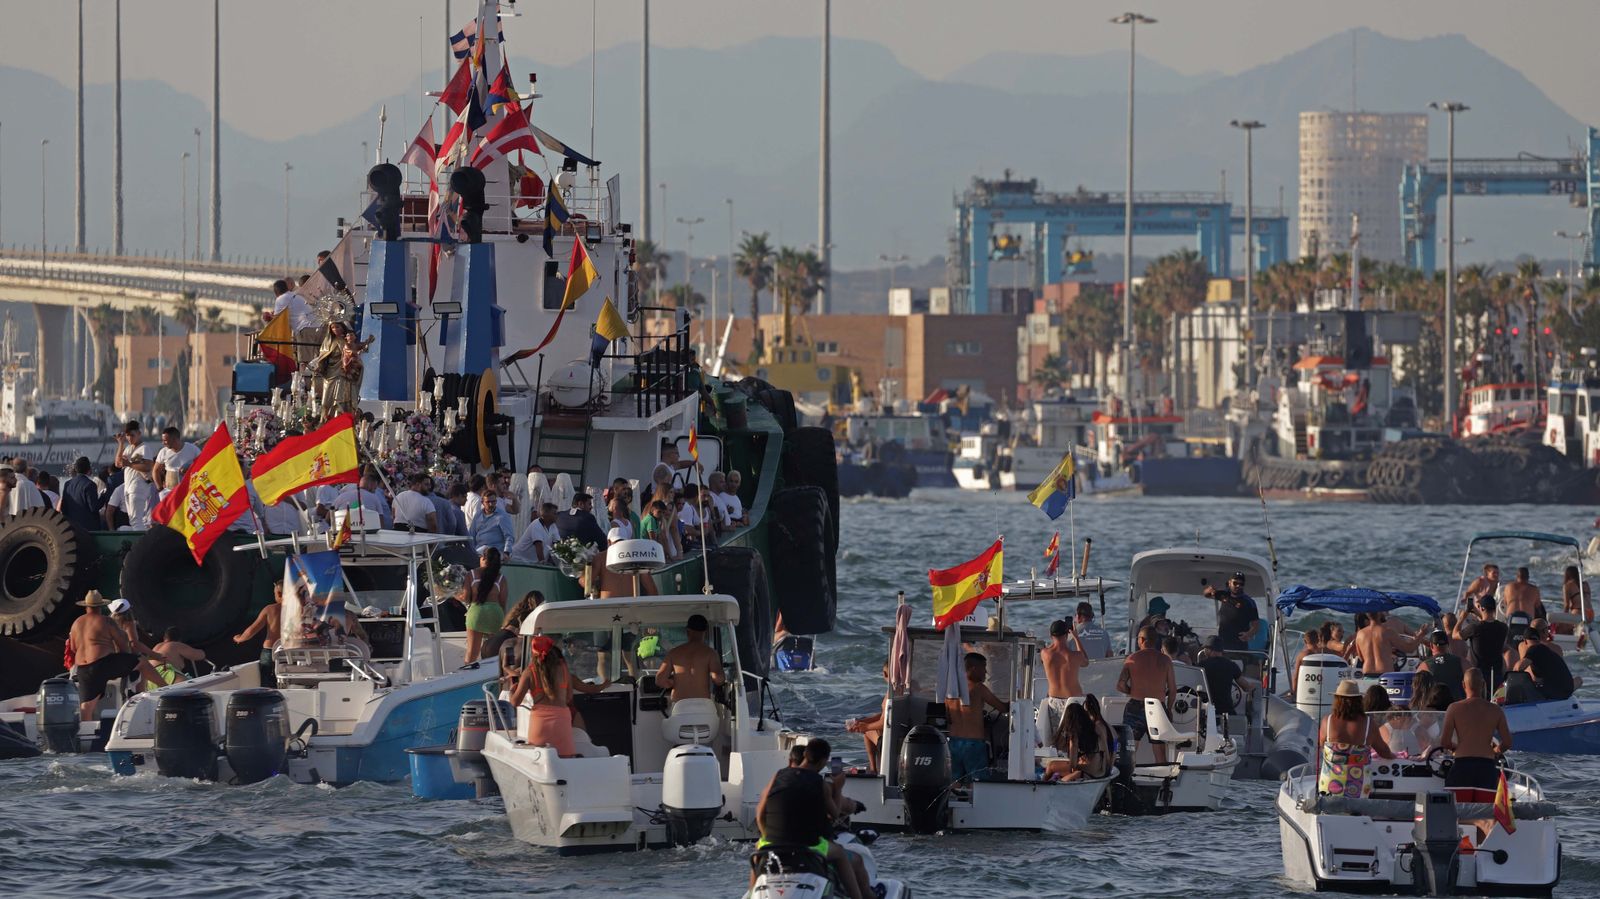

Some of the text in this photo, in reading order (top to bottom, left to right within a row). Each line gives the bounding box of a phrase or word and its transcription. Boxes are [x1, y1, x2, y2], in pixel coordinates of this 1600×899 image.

[618, 551, 657, 559] GARMIN
[1305, 673, 1322, 682] 200
[914, 756, 932, 766] 115
